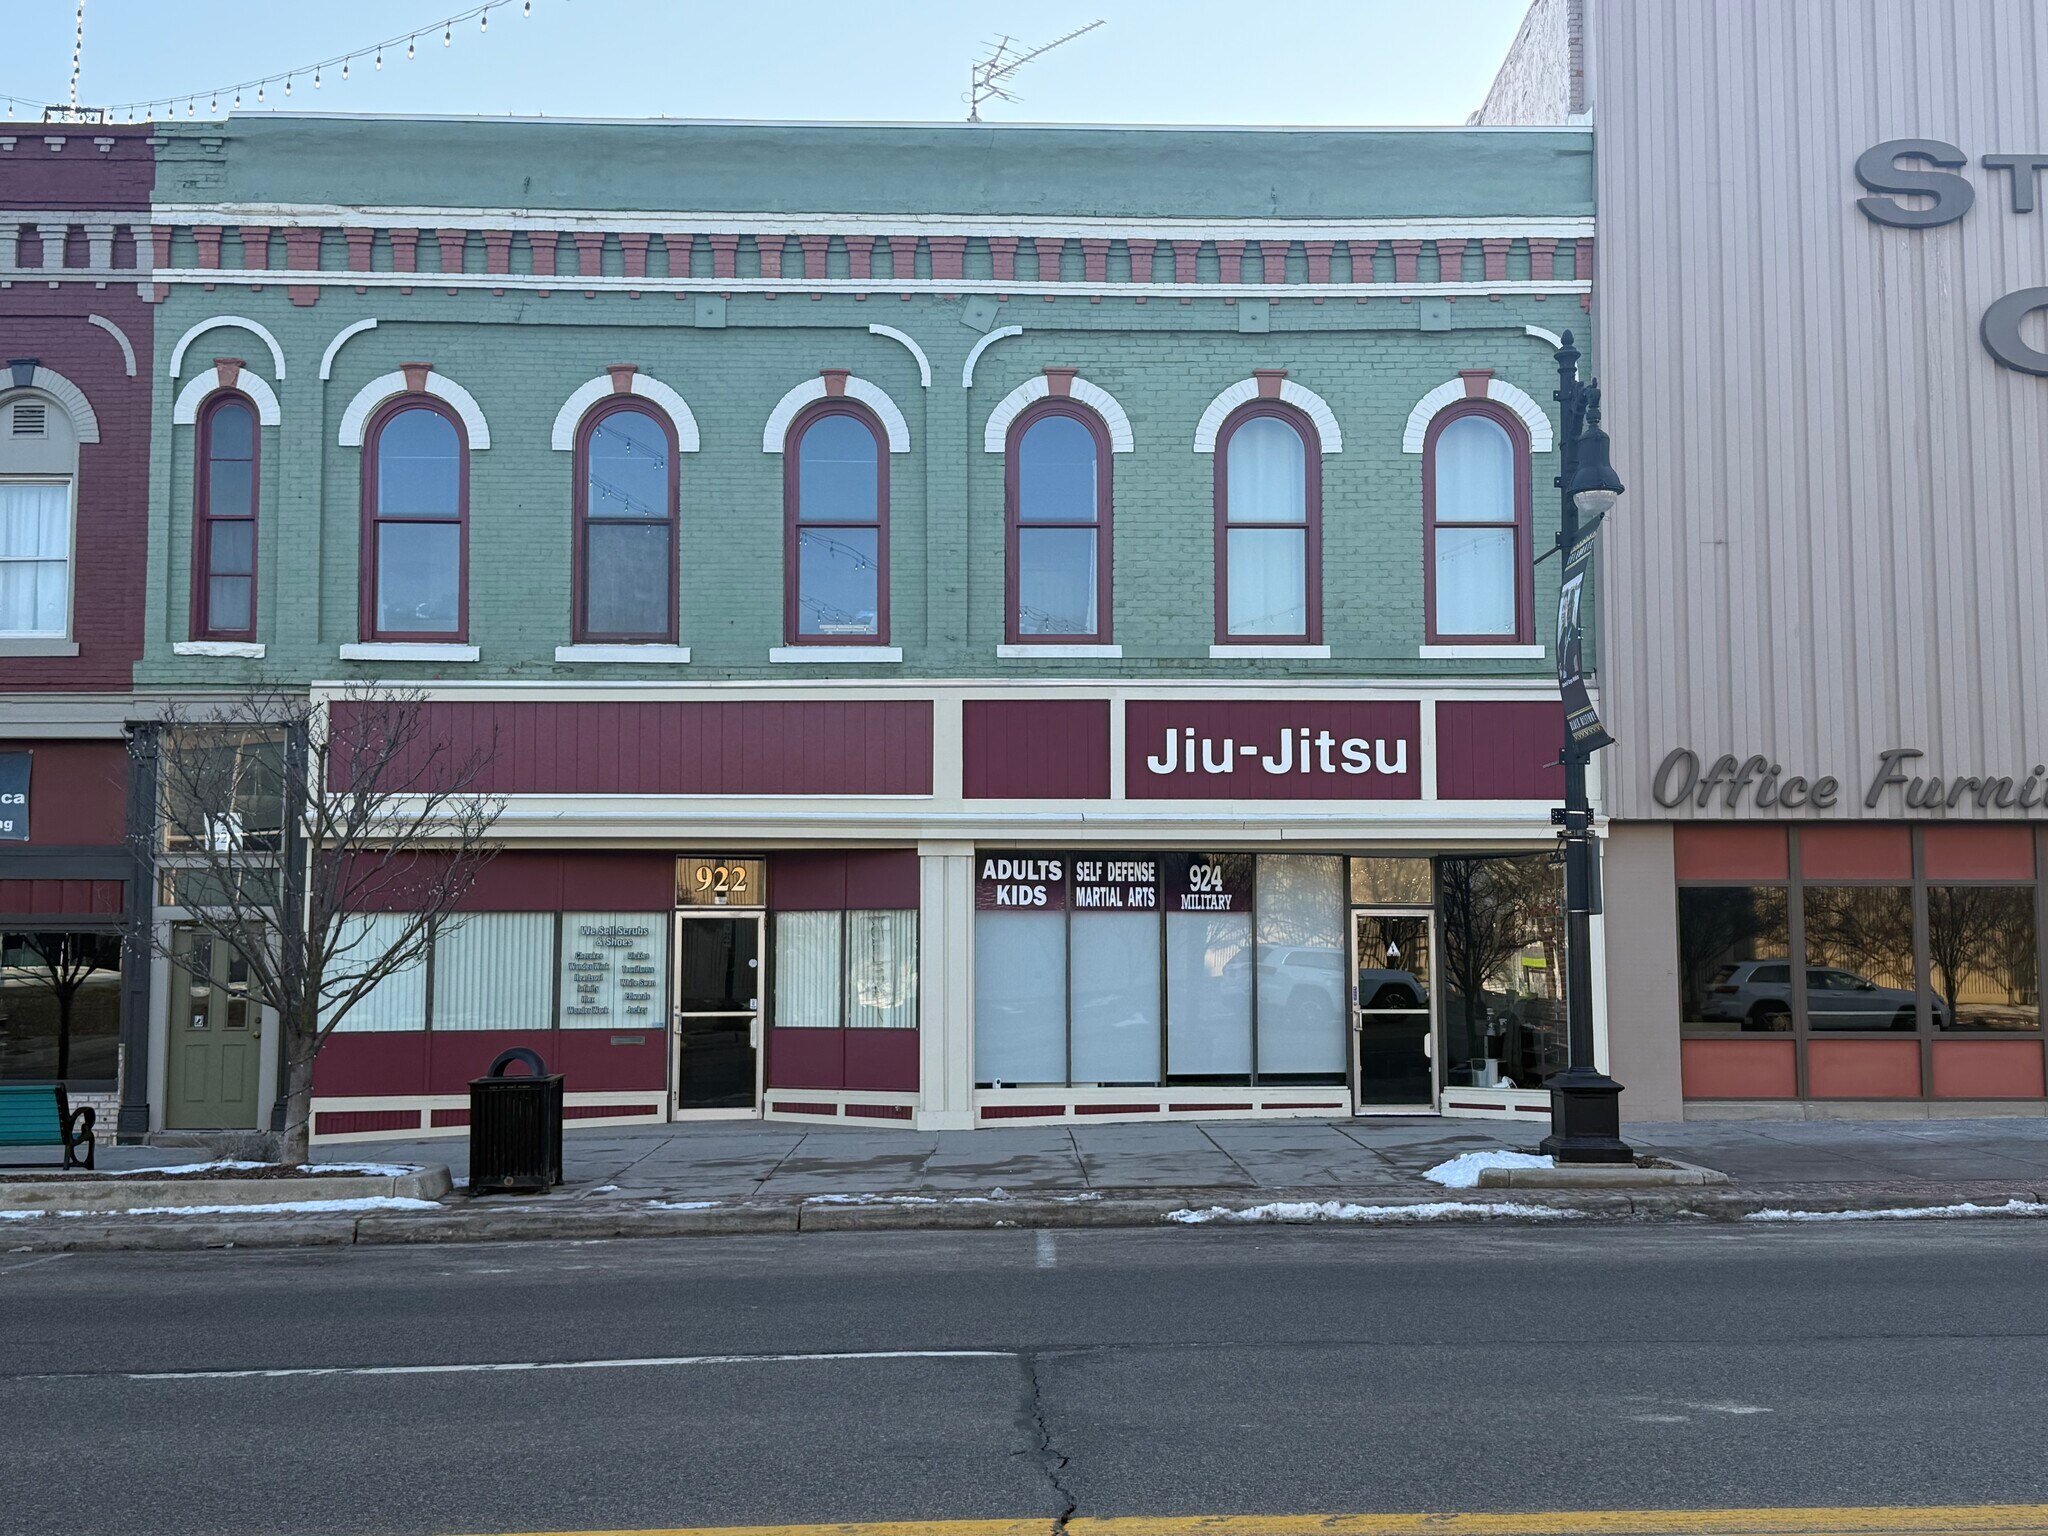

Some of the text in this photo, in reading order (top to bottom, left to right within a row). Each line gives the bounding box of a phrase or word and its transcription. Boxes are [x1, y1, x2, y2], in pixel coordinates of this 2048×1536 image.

[1147, 727, 1407, 775] Jiu-Jitsu
[1653, 747, 2048, 809] Office Furni
[694, 865, 748, 893] 922
[982, 859, 1063, 881] ADULTS
[1076, 861, 1156, 882] SELF DEFENSE
[1189, 864, 1223, 892] 924
[996, 884, 1048, 906] KIDS
[1076, 886, 1156, 907] MARTIAL ARTS
[1181, 894, 1233, 910] MILITARY
[581, 926, 649, 936] We Sell Scrubs
[596, 937, 633, 947] & Shoes
